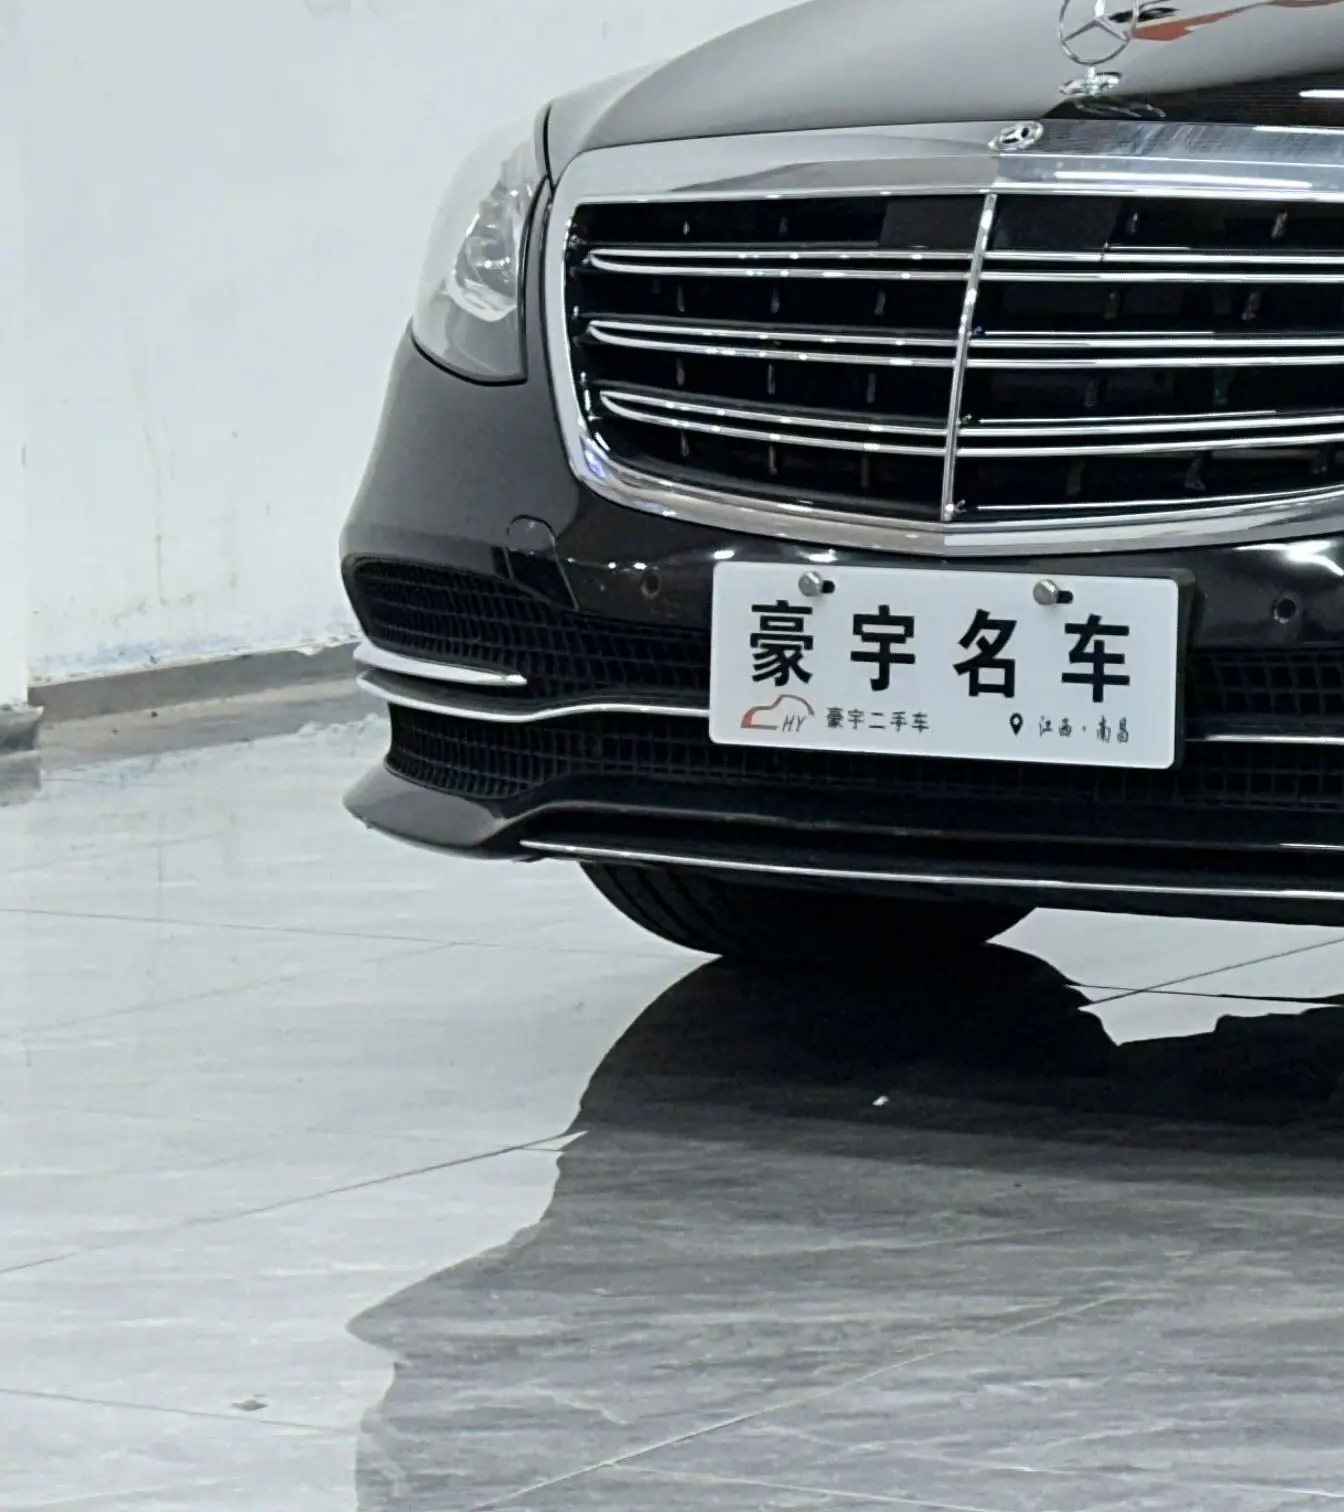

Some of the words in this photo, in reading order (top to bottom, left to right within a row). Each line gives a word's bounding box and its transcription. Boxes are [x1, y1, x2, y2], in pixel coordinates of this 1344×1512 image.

[750, 599, 1131, 703] 豪宇名车
[782, 714, 806, 733] HY
[826, 706, 930, 734] 豪宇二手车
